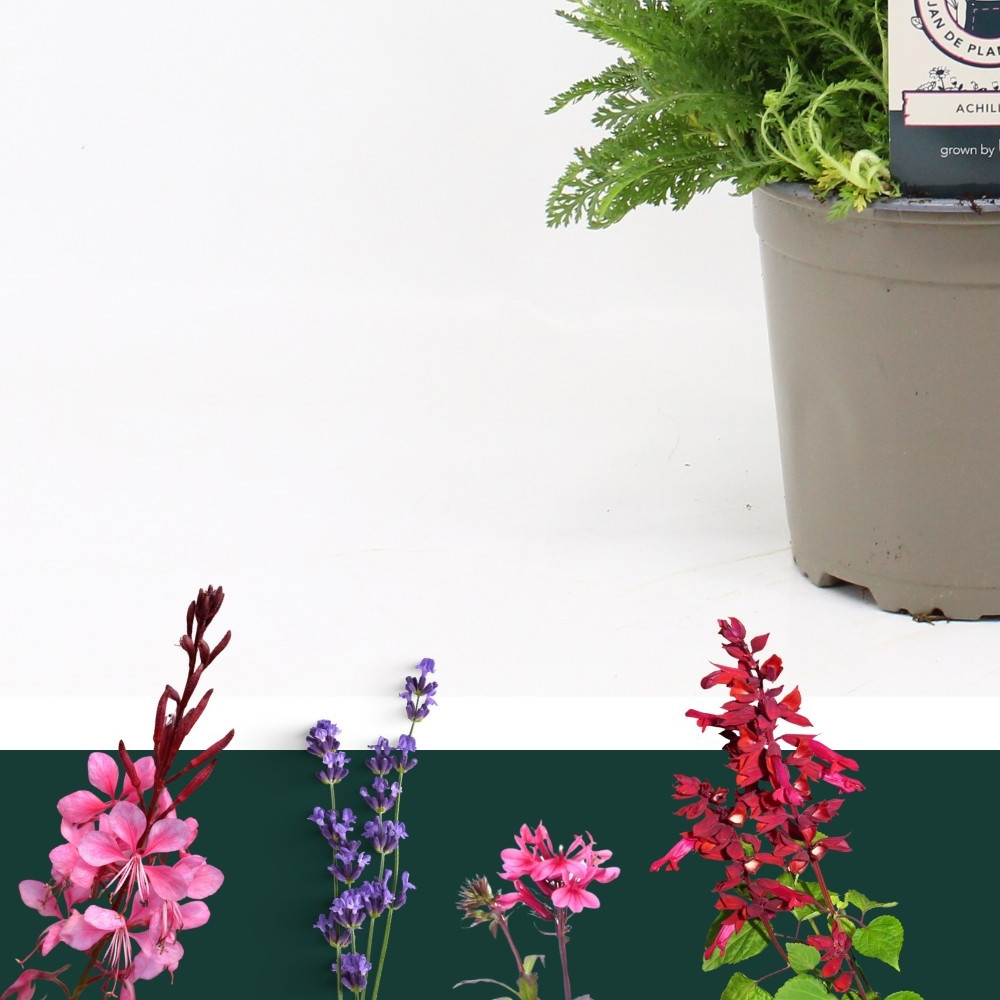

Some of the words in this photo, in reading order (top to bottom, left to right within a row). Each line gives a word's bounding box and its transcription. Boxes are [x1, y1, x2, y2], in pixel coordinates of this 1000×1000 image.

[927, 0, 946, 30] JAN
[944, 30, 964, 48] DE
[940, 145, 978, 157] grown
[980, 143, 995, 157] by
